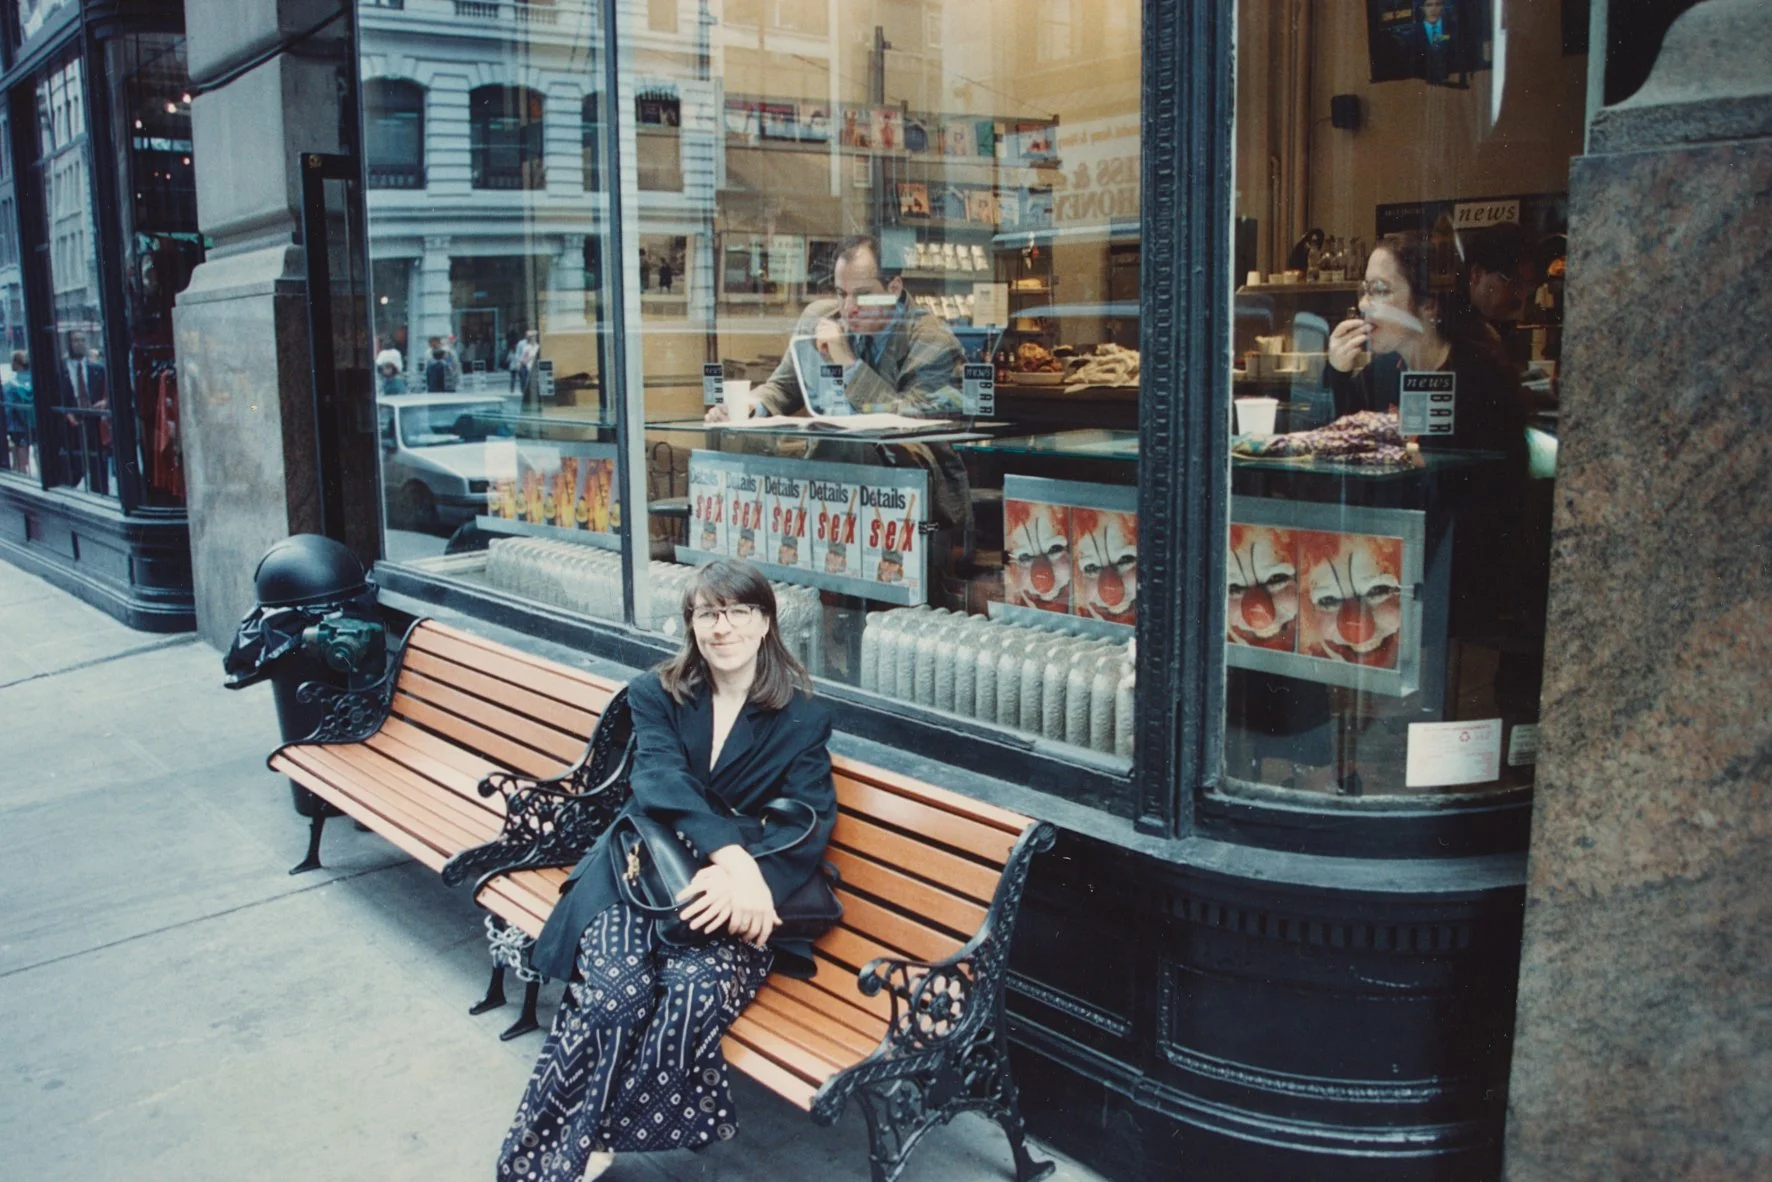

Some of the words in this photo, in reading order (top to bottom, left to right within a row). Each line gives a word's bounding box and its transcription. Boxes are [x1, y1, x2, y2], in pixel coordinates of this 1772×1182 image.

[1459, 205, 1516, 222] news
[1407, 378, 1450, 388] news
[979, 382, 992, 414] BAR
[1429, 394, 1453, 432] BAR
[764, 475, 800, 498] Details
[809, 480, 849, 504] Details
[860, 484, 906, 510] Details
[696, 495, 723, 524] sex
[732, 500, 763, 530] sex
[772, 506, 808, 537] sex
[818, 511, 857, 544] sex
[869, 518, 916, 552] sex
